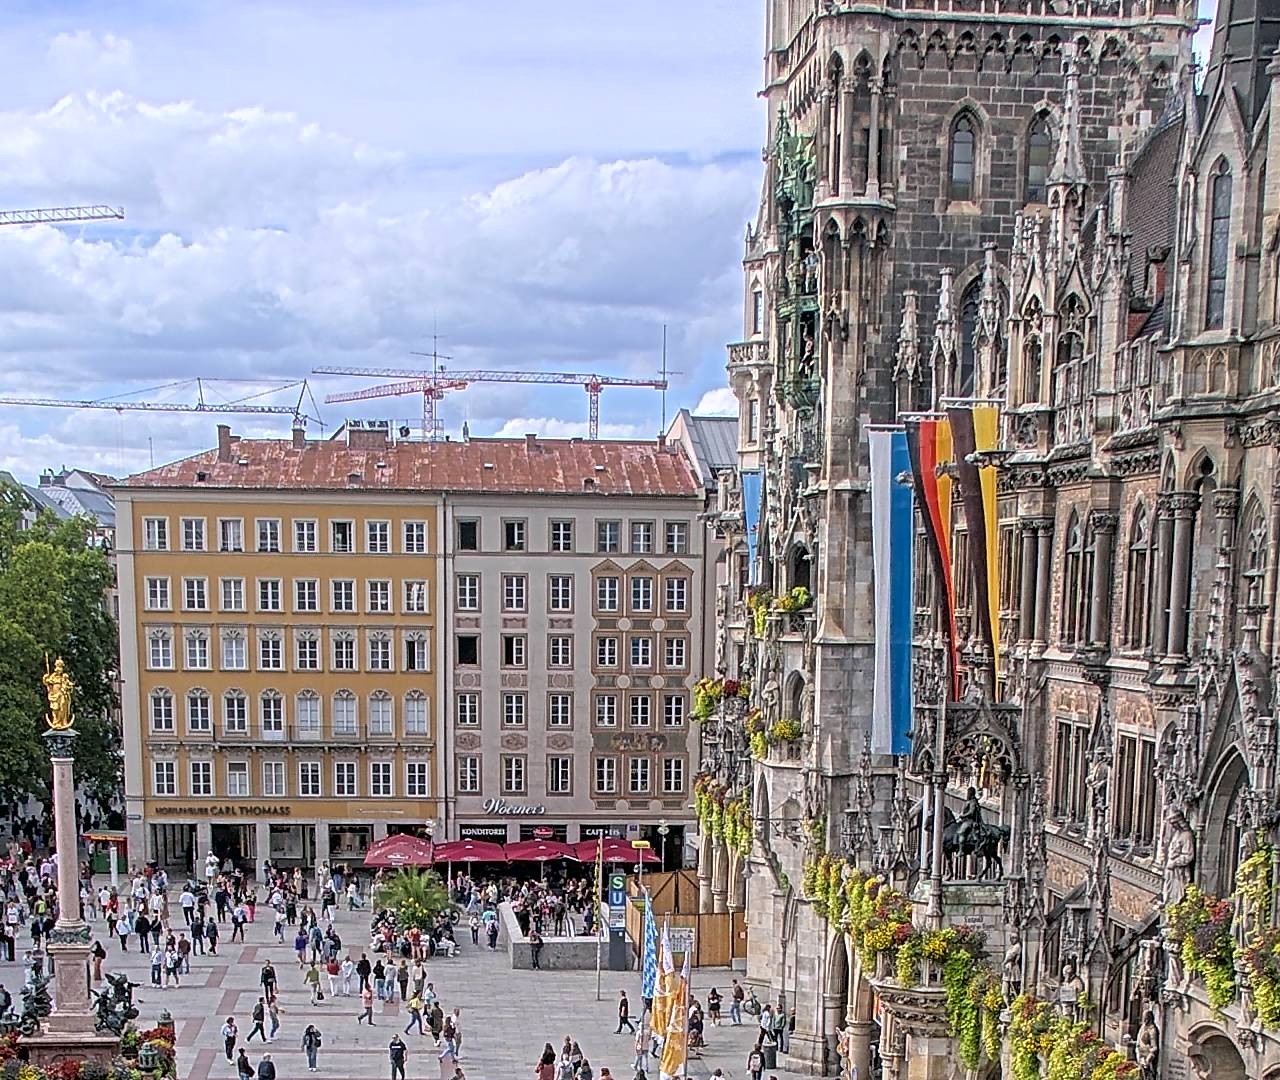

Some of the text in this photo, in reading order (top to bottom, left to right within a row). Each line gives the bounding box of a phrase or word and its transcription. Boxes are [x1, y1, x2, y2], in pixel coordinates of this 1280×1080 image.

[210, 806, 237, 817] CARL
[239, 806, 291, 817] THOMASS
[612, 876, 624, 890] S
[613, 892, 623, 904] U
